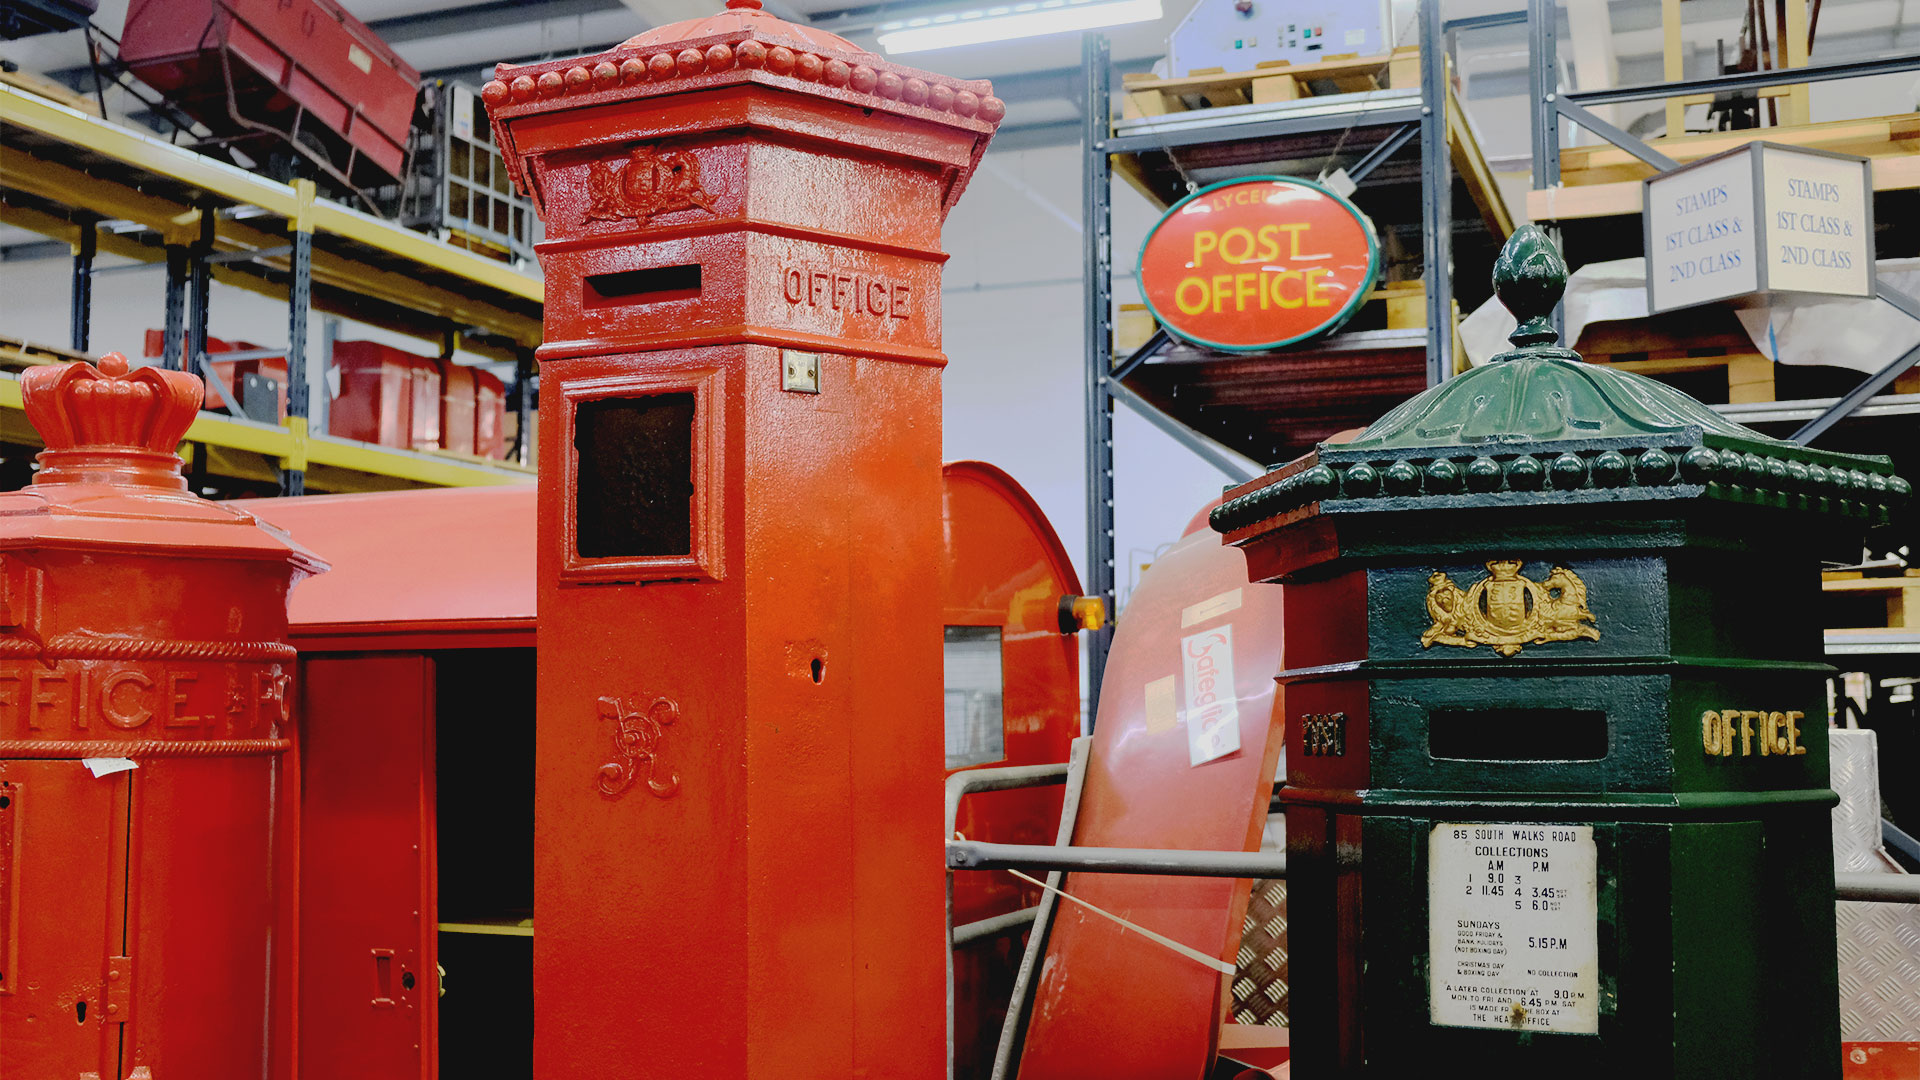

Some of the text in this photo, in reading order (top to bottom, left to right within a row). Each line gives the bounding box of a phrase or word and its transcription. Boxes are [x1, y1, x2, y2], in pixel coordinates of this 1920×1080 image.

[1787, 178, 1840, 203] STAMPS
[1676, 185, 1728, 215] STAMPS
[1776, 211, 1853, 237] 1ST CLASS &
[1665, 216, 1743, 251] 1ST CLASS &
[1193, 222, 1312, 267] POST
[1781, 245, 1852, 270] 2ND CLASS
[1670, 249, 1742, 282] 2ND CLASS
[783, 267, 910, 320] OFFICE
[1175, 267, 1331, 316] OFFICE
[1702, 709, 1807, 757] OFFICE
[1453, 829, 1576, 842] 85 SOUTH WALKS ROAD
[1475, 846, 1549, 858] COLLECTIONS
[1532, 861, 1549, 872] P.M
[1488, 873, 1504, 884] 9.0
[1515, 875, 1521, 885] 3
[1466, 886, 1472, 895] 2
[1482, 885, 1504, 896] 11.45
[1515, 888, 1522, 897] 4
[1532, 887, 1555, 898] 3.45
[1515, 901, 1521, 910] 5
[1532, 900, 1548, 911] 6.0
[1457, 920, 1500, 930] SUNDAYS
[1454, 944, 1508, 956] (NOT BOXING DAY)
[1528, 936, 1567, 950] 5.15 P.M
[1538, 970, 1578, 978] COLLECTION
[1454, 985, 1478, 993] LATER
[1480, 987, 1526, 996] COLLECTION
[1553, 989, 1569, 999] 9.0
[1520, 997, 1542, 1007] 6.45
[1473, 1013, 1487, 1022] THE
[1494, 1015, 1513, 1024] HEA
